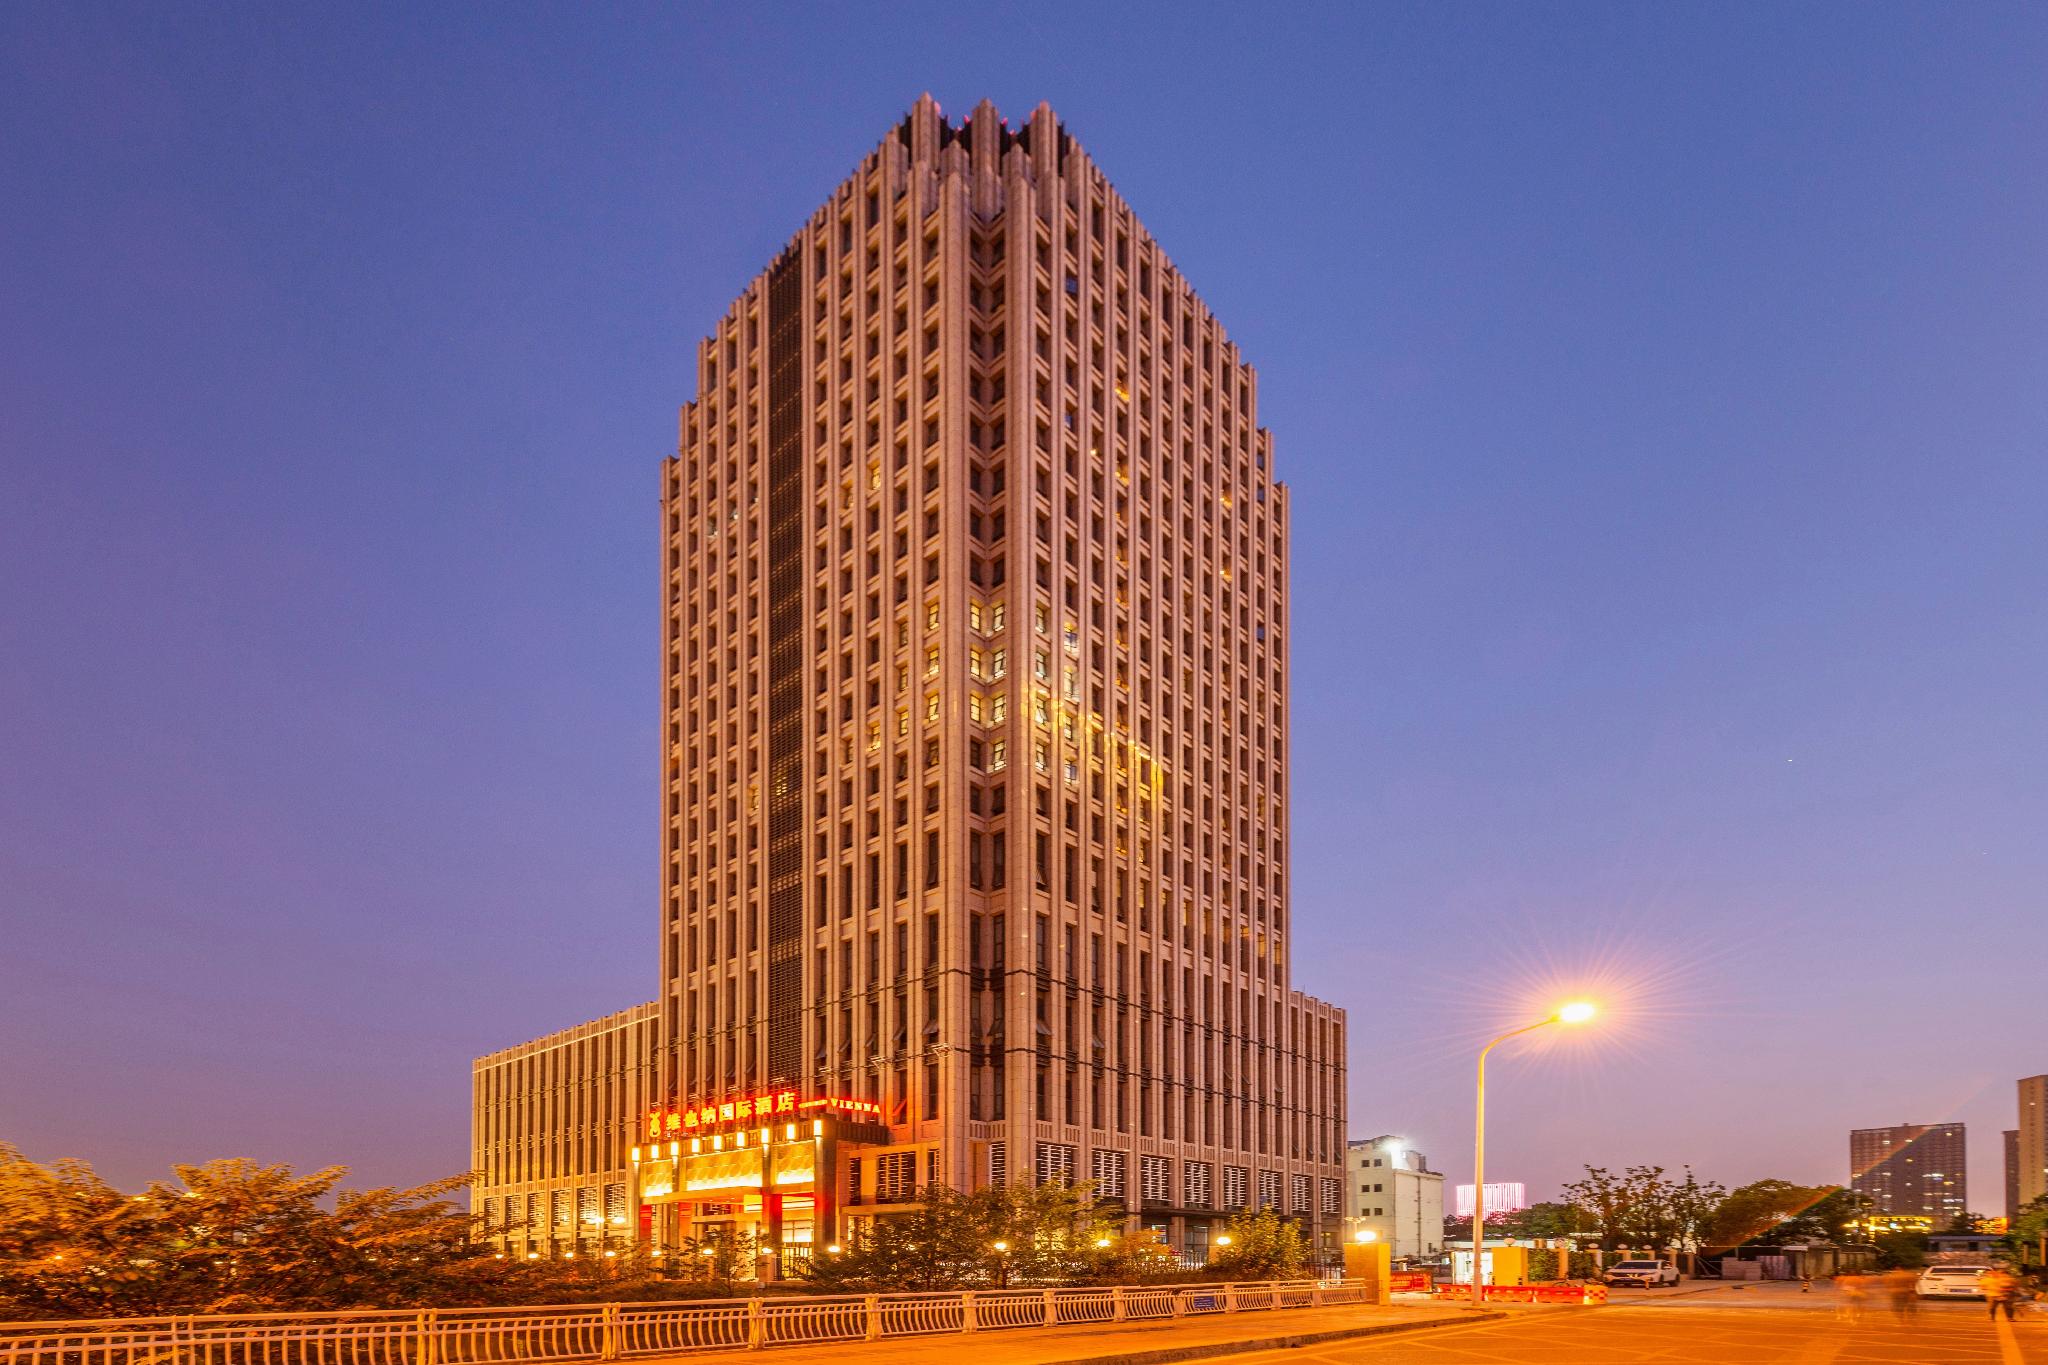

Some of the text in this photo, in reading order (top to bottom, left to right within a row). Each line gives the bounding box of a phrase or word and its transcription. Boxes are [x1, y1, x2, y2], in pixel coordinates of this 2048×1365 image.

[666, 1092, 795, 1131] 维也纳国际酒店
[831, 1098, 880, 1113] VIENNA
